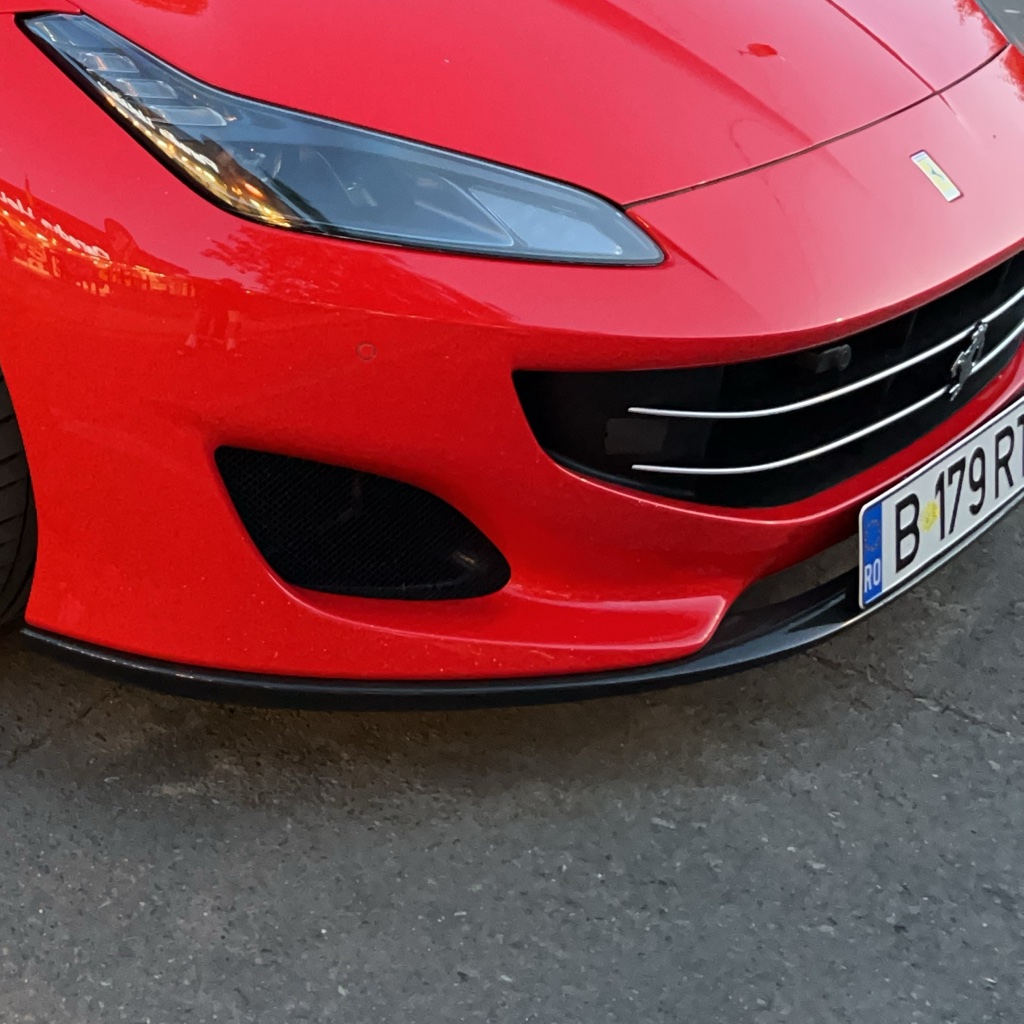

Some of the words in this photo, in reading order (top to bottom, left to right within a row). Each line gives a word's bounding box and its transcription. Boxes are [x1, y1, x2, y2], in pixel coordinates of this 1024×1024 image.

[895, 493, 920, 573] B
[935, 447, 986, 541] 179
[864, 558, 881, 593] RO
